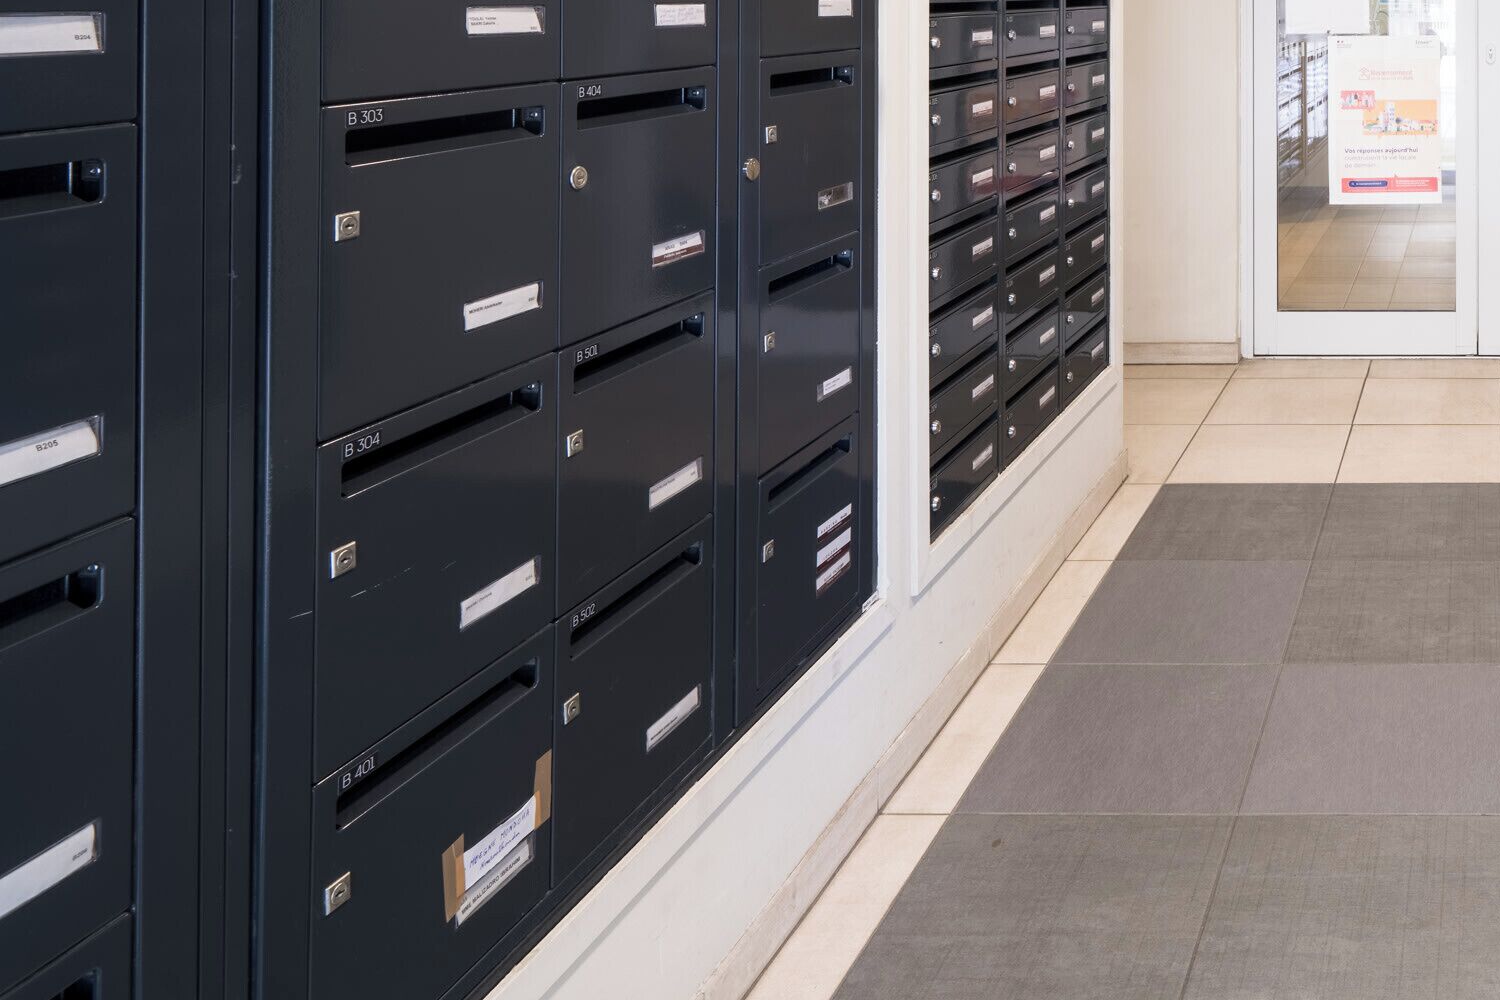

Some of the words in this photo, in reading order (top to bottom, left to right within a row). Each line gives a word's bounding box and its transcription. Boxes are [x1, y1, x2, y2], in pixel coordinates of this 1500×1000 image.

[578, 88, 585, 98] B
[586, 85, 602, 97] 404
[348, 111, 357, 126] B
[360, 108, 383, 123] 303
[1356, 147, 1383, 155] réponses
[1384, 146, 1419, 155] aujourd'hui
[576, 351, 583, 363] B
[584, 346, 598, 359] 501
[36, 439, 59, 452] B205
[344, 443, 353, 458] B
[356, 431, 380, 453] 304
[572, 614, 579, 627] B
[580, 603, 596, 619] 502
[342, 774, 351, 789] B
[355, 756, 376, 778] 401
